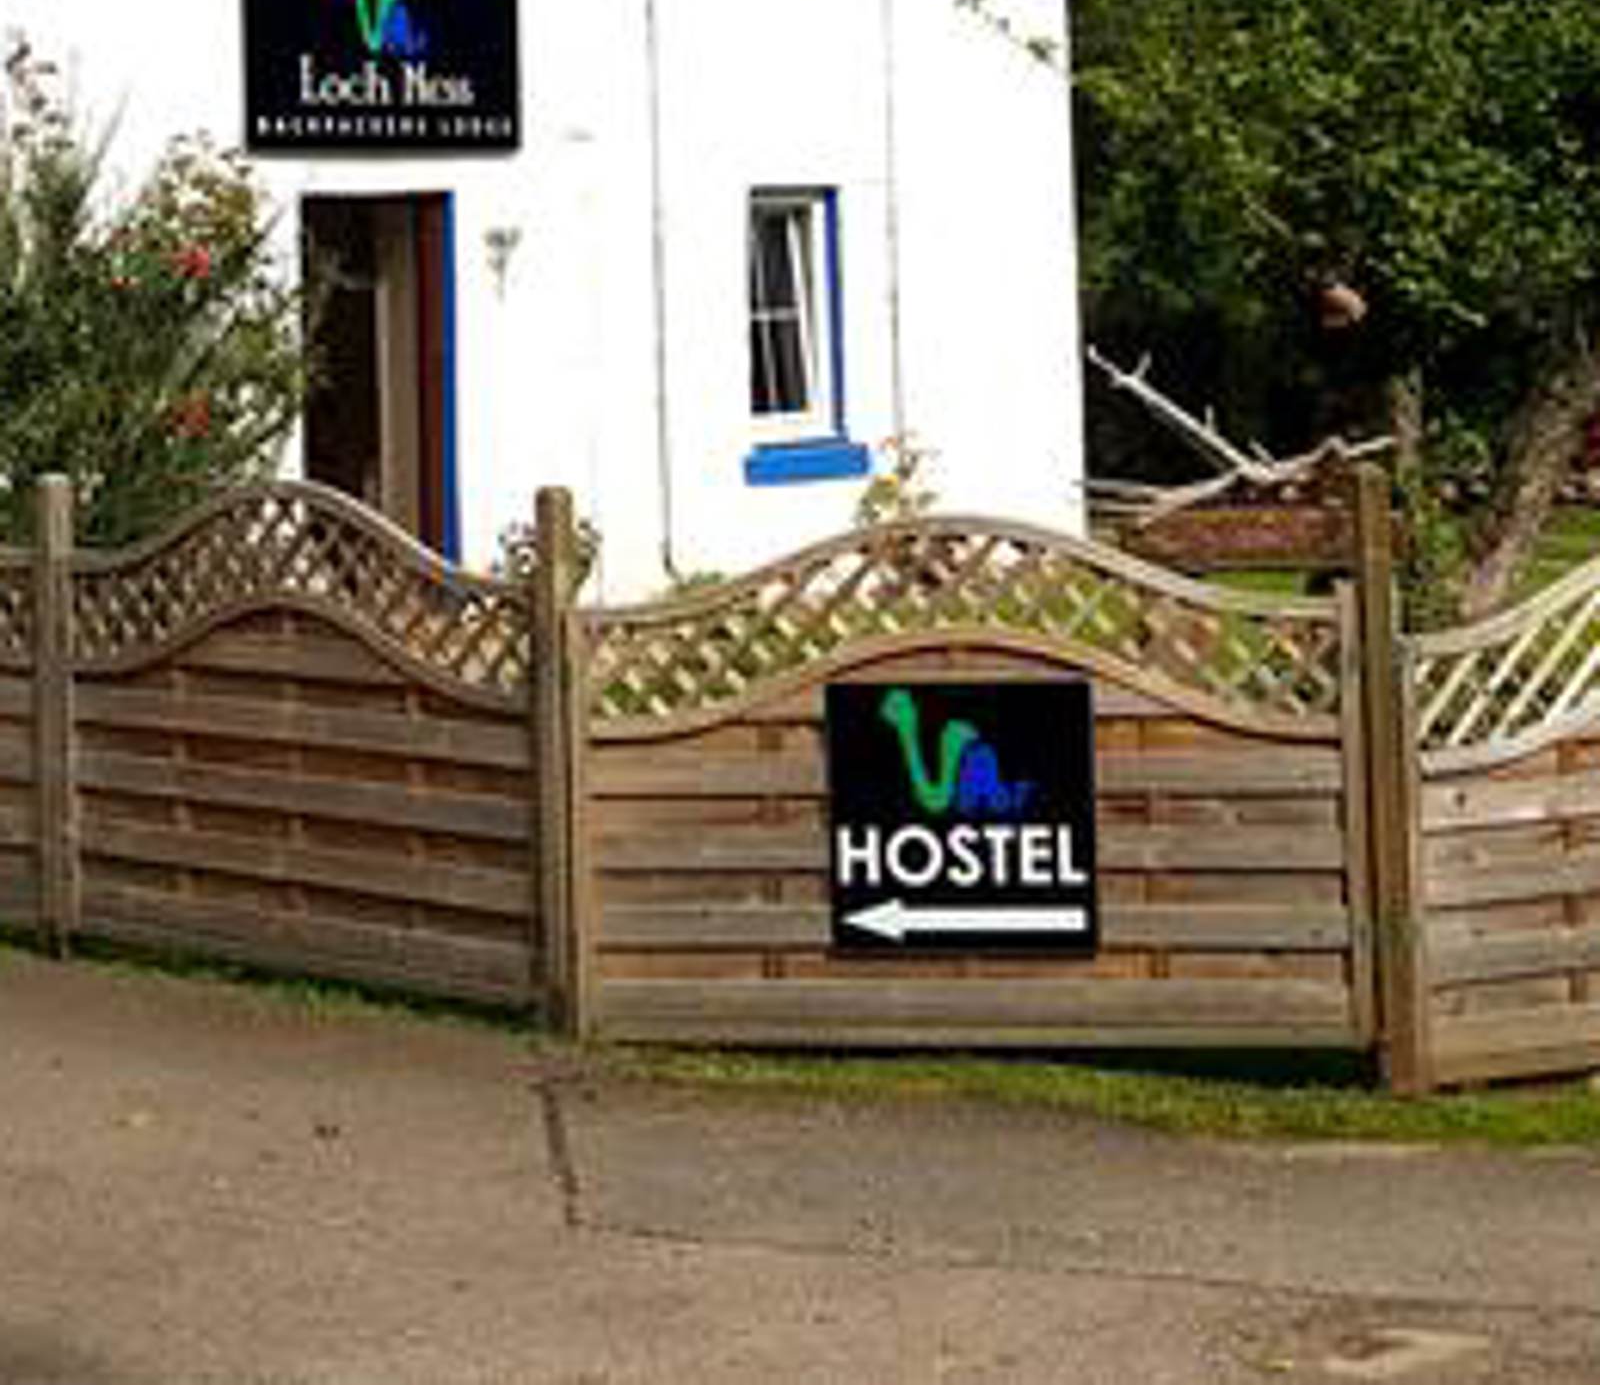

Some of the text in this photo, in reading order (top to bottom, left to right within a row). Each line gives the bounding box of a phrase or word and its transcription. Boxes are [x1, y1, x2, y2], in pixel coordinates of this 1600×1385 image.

[299, 54, 476, 106] Loch Ness
[836, 823, 1089, 887] HOSTEL
